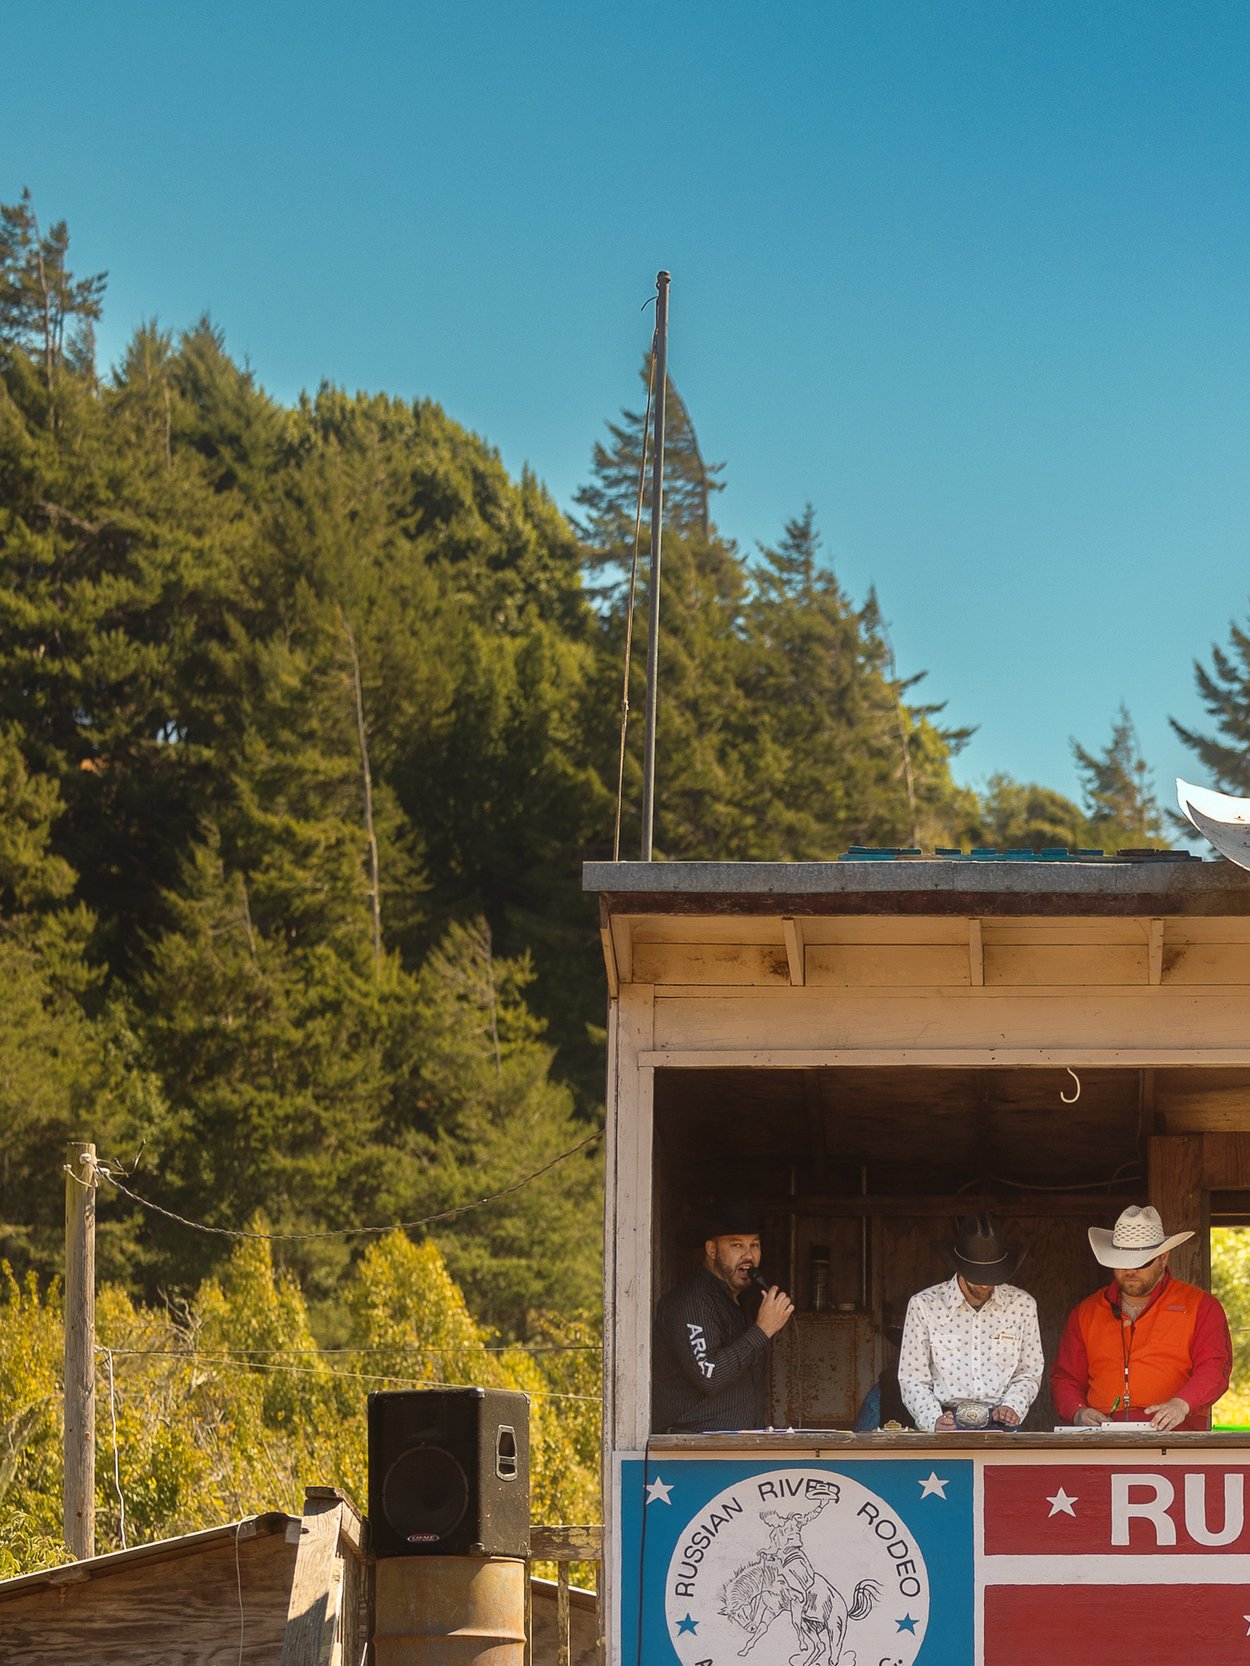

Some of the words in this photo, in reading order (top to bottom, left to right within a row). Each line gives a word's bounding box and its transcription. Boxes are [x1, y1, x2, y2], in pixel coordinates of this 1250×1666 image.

[675, 1497, 743, 1597] RUSSIAN
[757, 1478, 841, 1504] RIVER
[856, 1501, 921, 1597] RODEO
